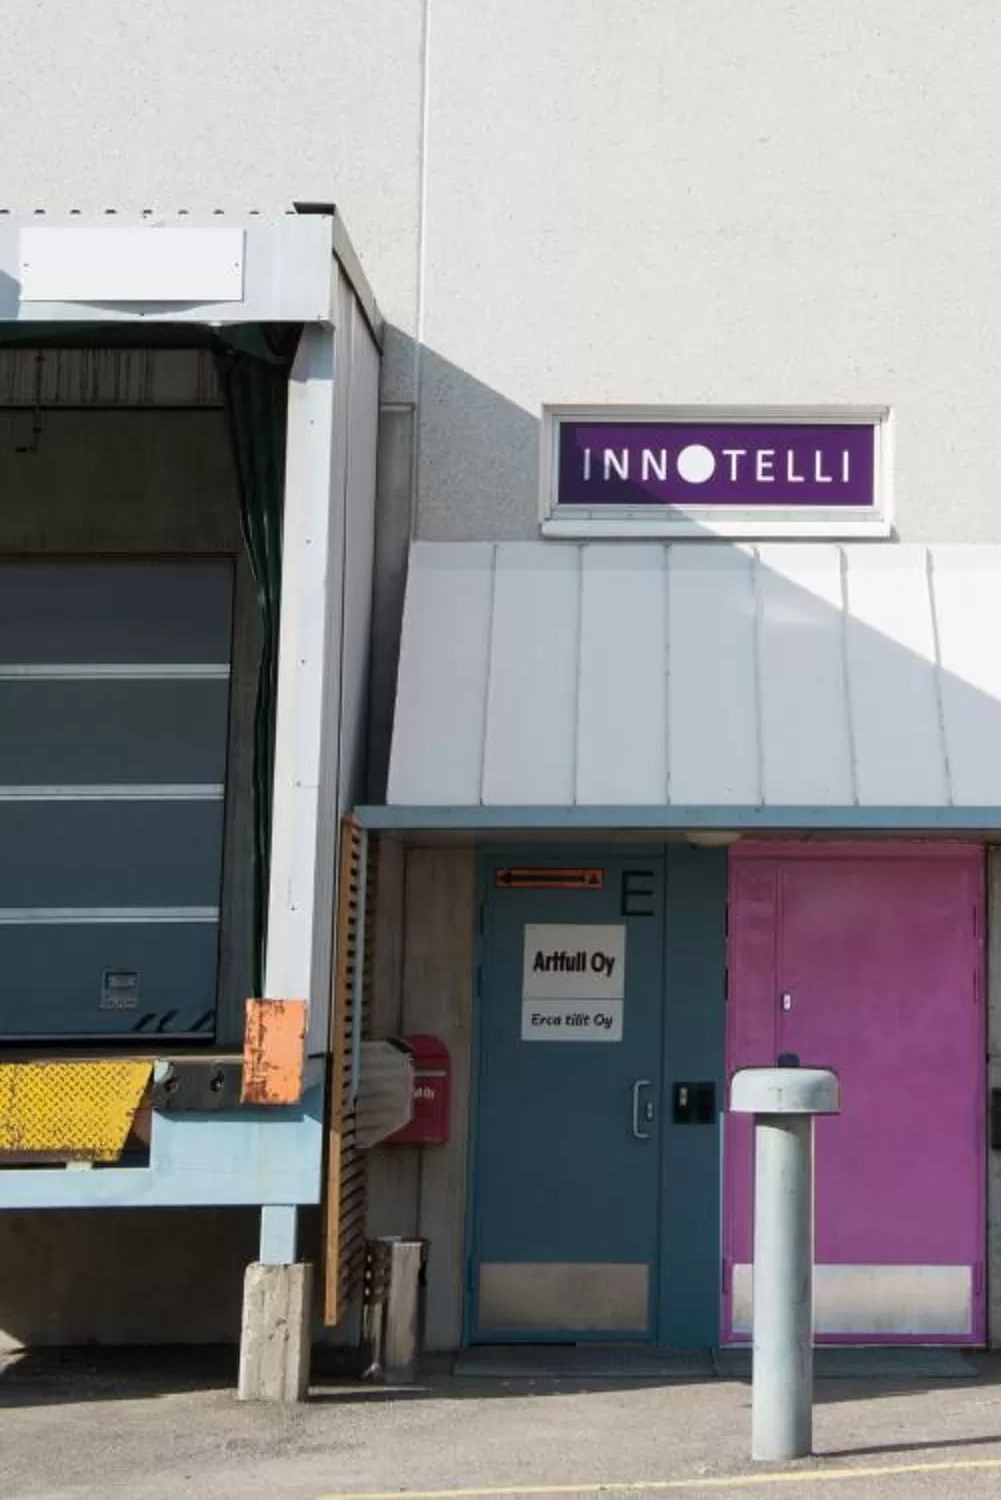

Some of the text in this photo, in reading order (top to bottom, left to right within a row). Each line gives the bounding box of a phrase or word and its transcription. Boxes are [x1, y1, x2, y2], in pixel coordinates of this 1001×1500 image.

[621, 870, 655, 917] E
[533, 951, 615, 977] Artfull Oy
[593, 1013, 613, 1029] Oy
